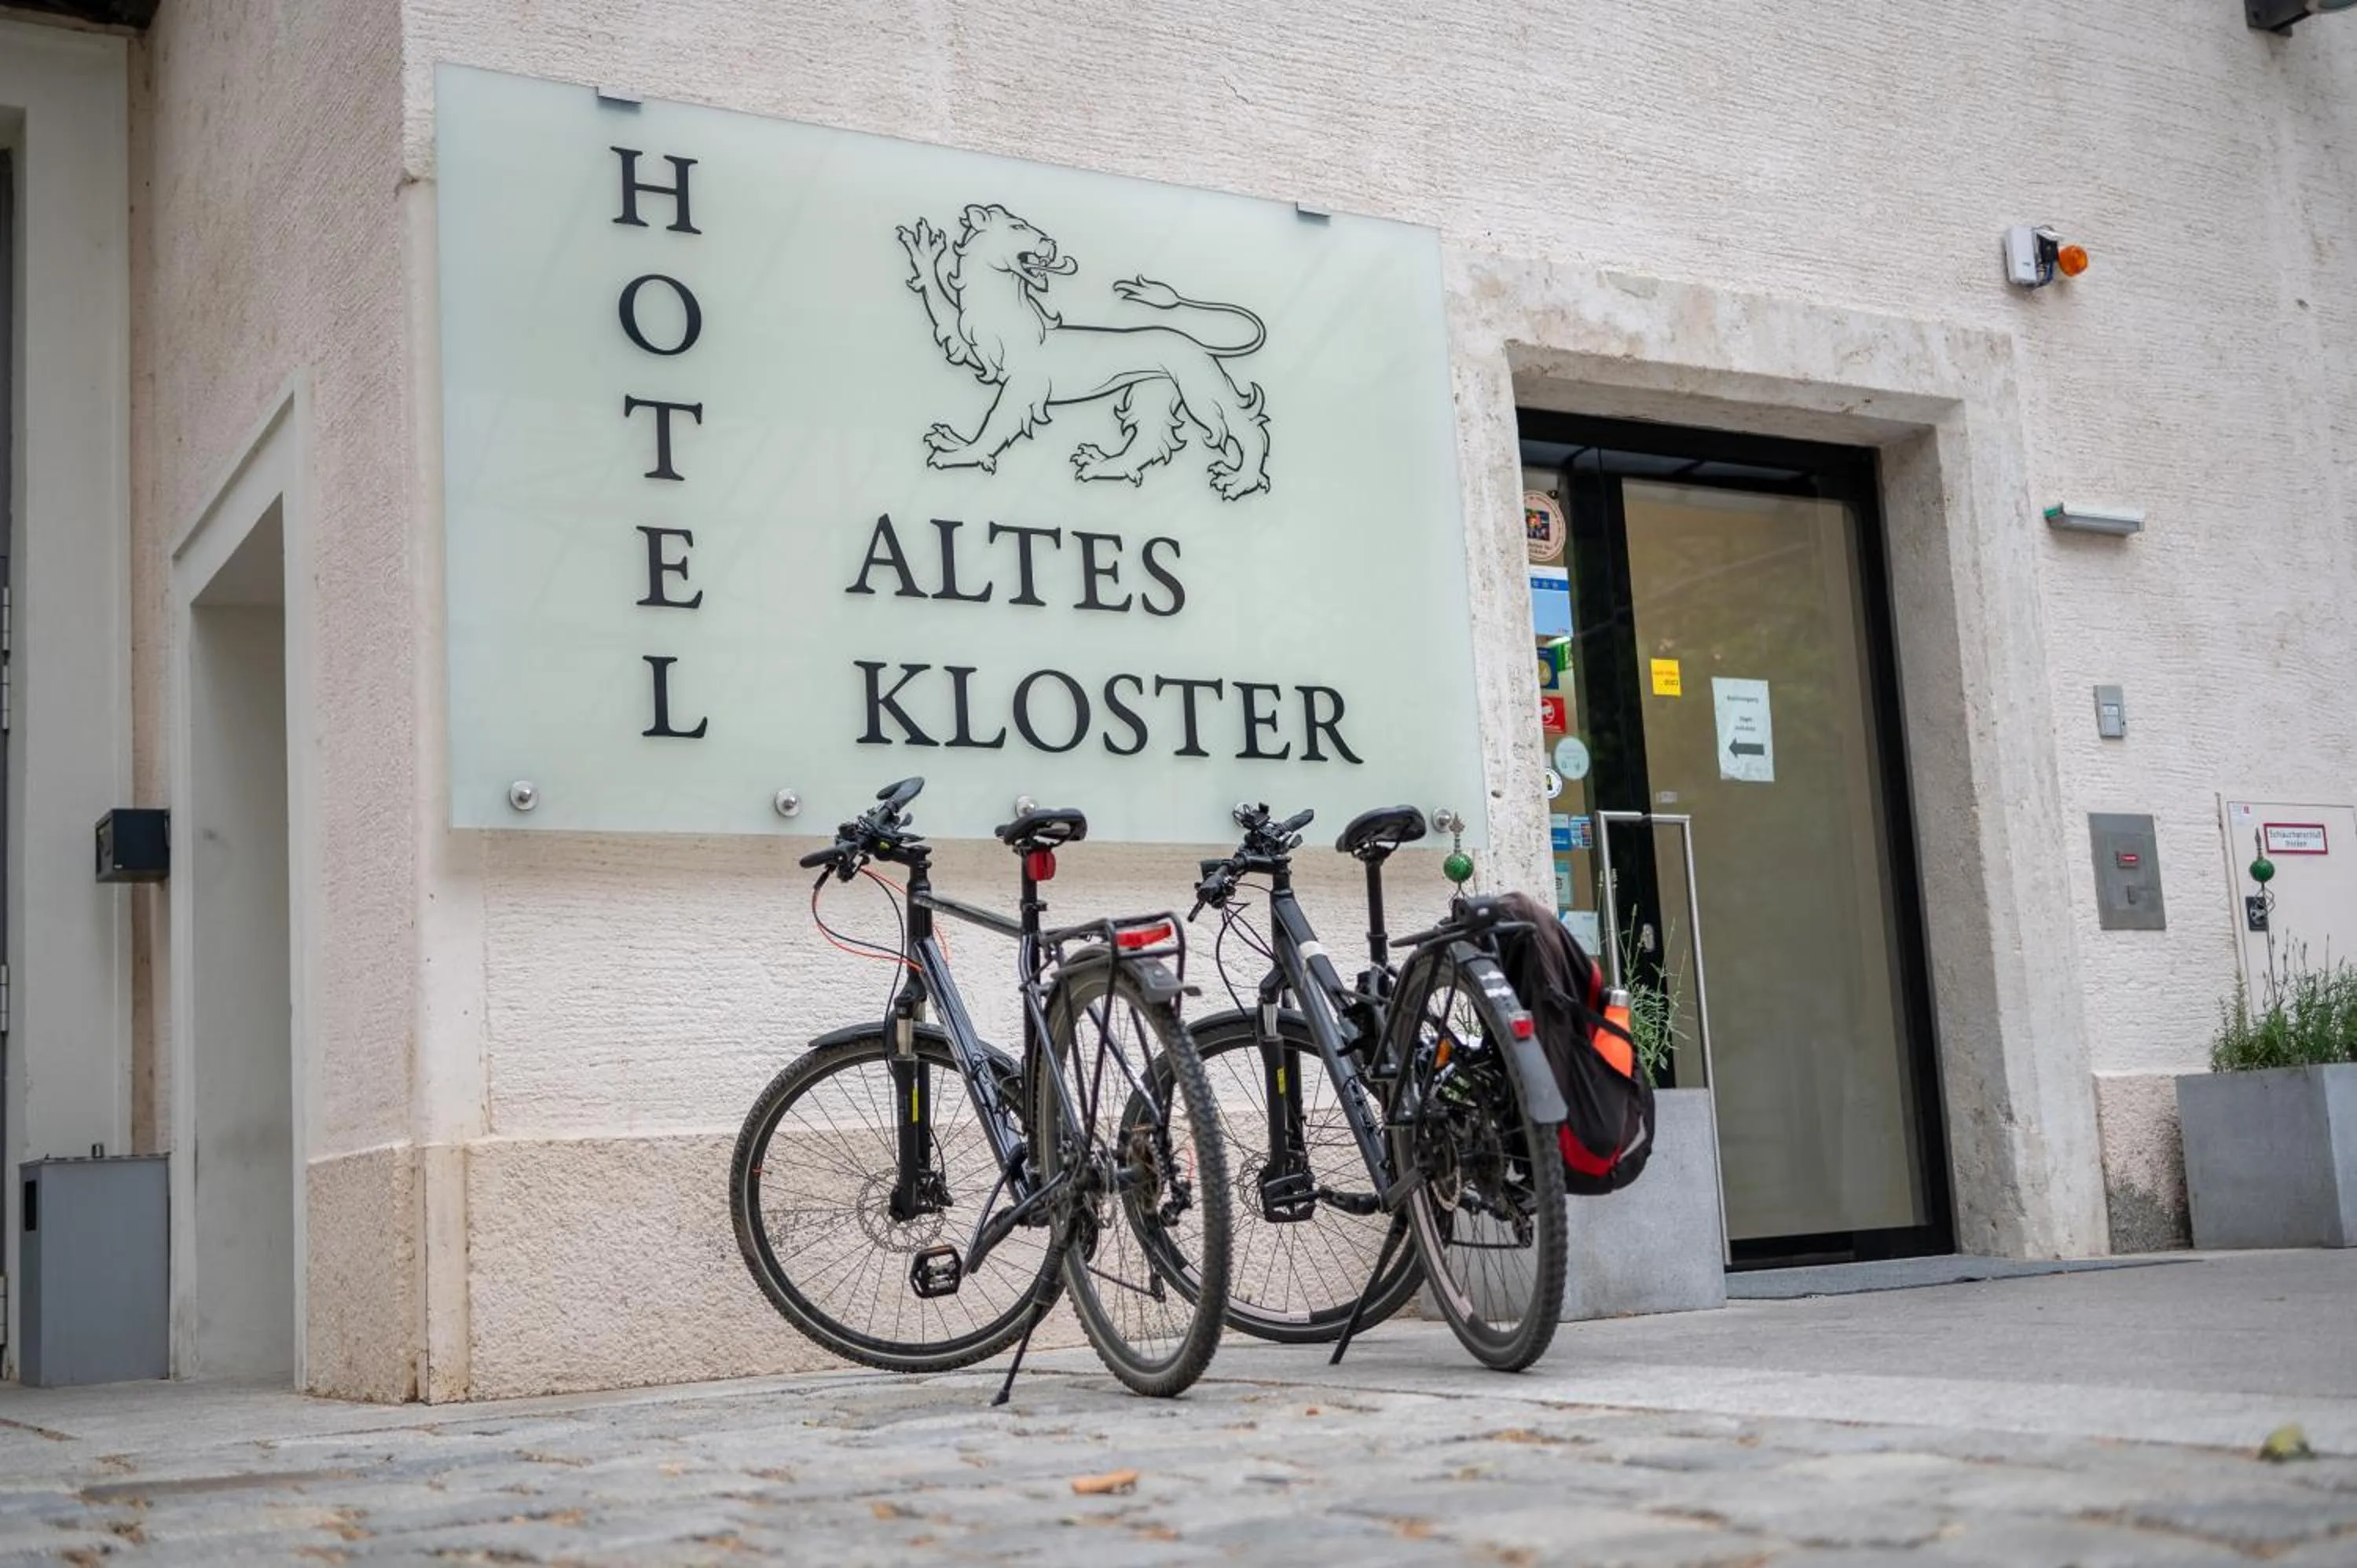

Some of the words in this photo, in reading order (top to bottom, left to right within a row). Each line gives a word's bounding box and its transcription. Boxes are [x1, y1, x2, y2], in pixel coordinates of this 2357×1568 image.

[609, 145, 709, 740] HOTEL
[845, 513, 1186, 617] ALTES
[852, 659, 1365, 765] KLOSTER
